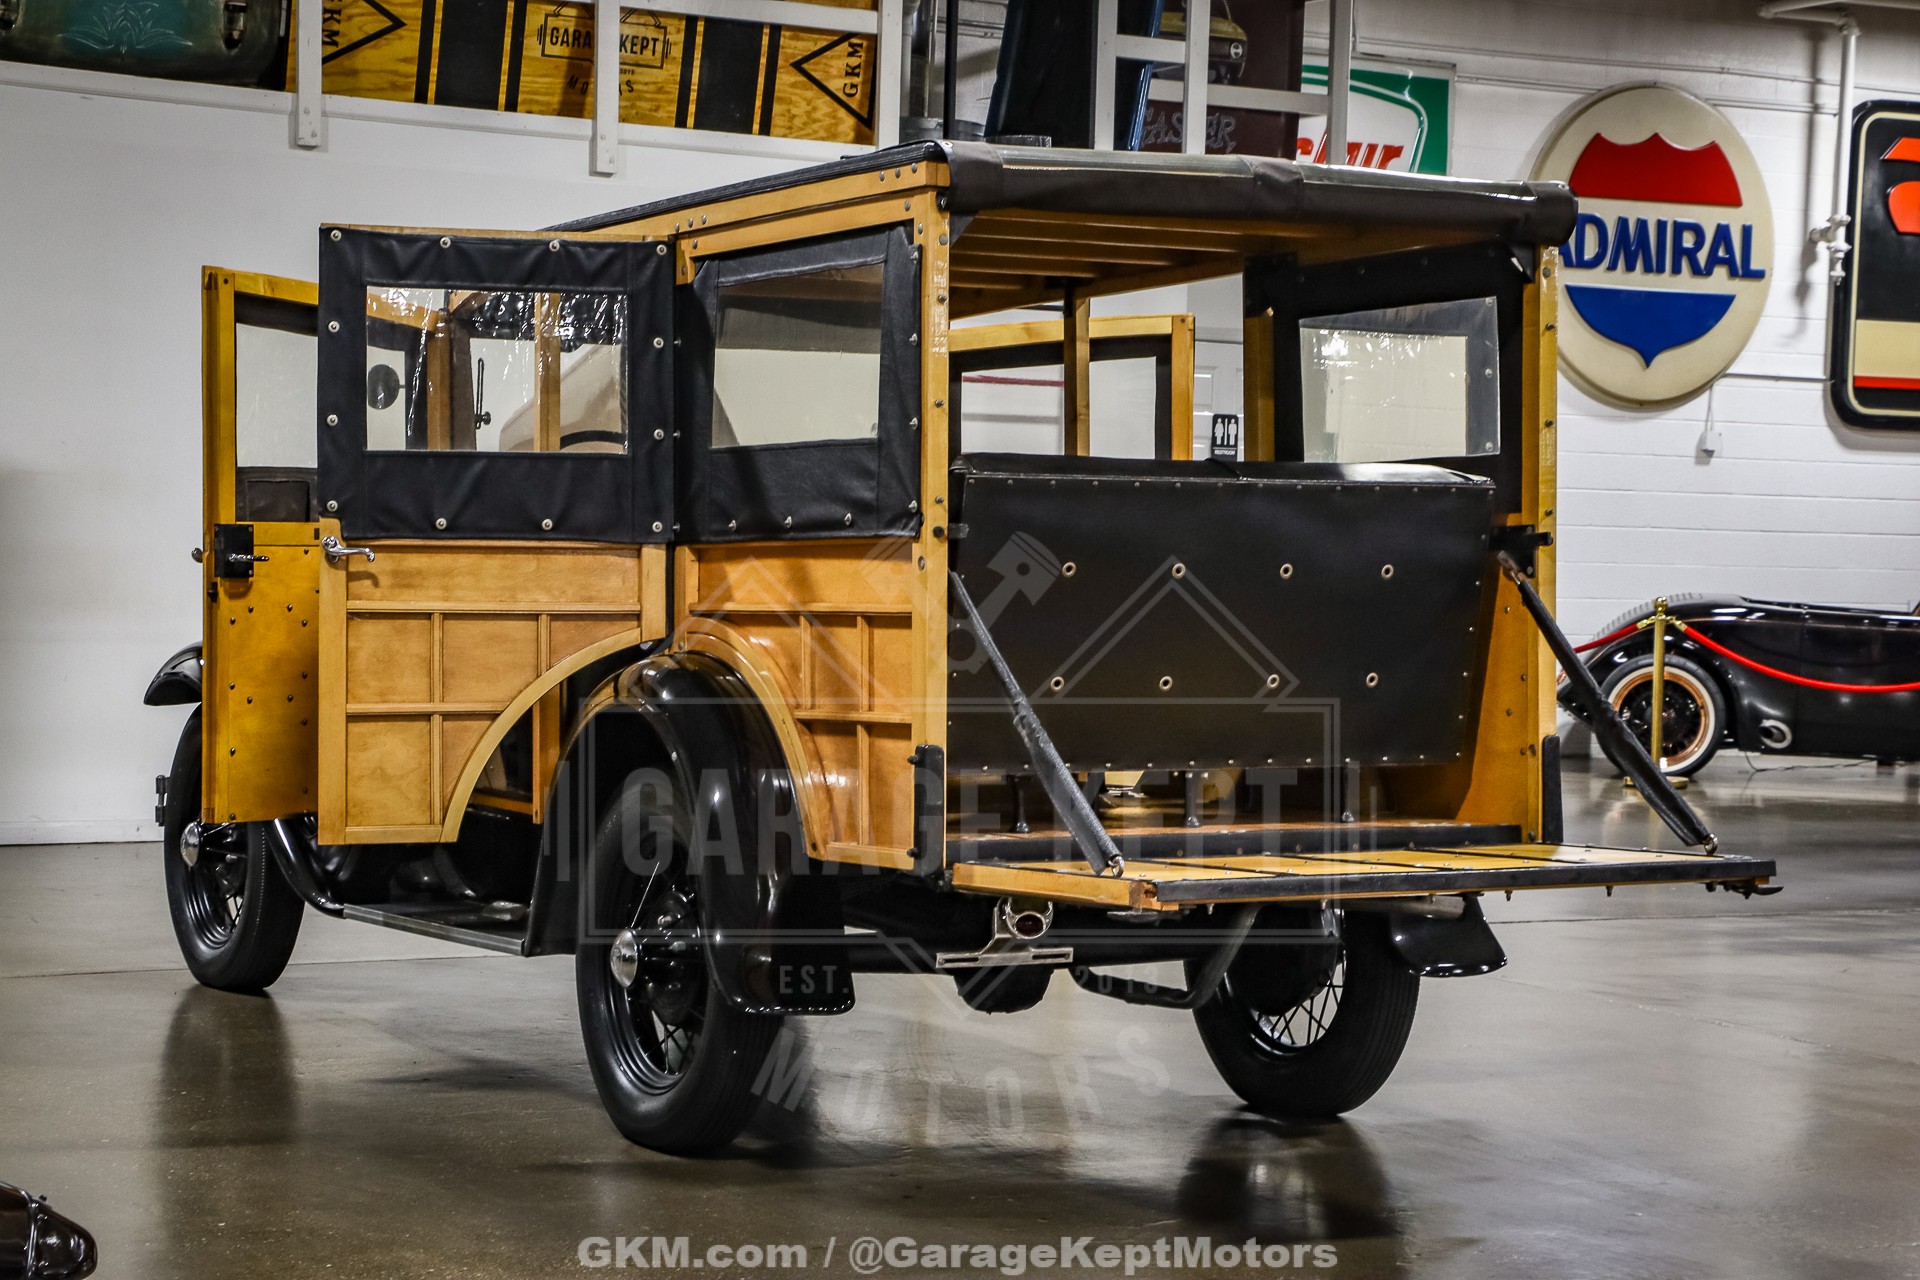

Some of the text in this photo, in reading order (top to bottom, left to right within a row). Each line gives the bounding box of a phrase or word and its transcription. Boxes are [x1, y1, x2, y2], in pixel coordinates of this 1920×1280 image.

[321, 0, 342, 48] KM
[549, 26, 660, 57] GARA KEPT
[842, 41, 864, 98] GKM
